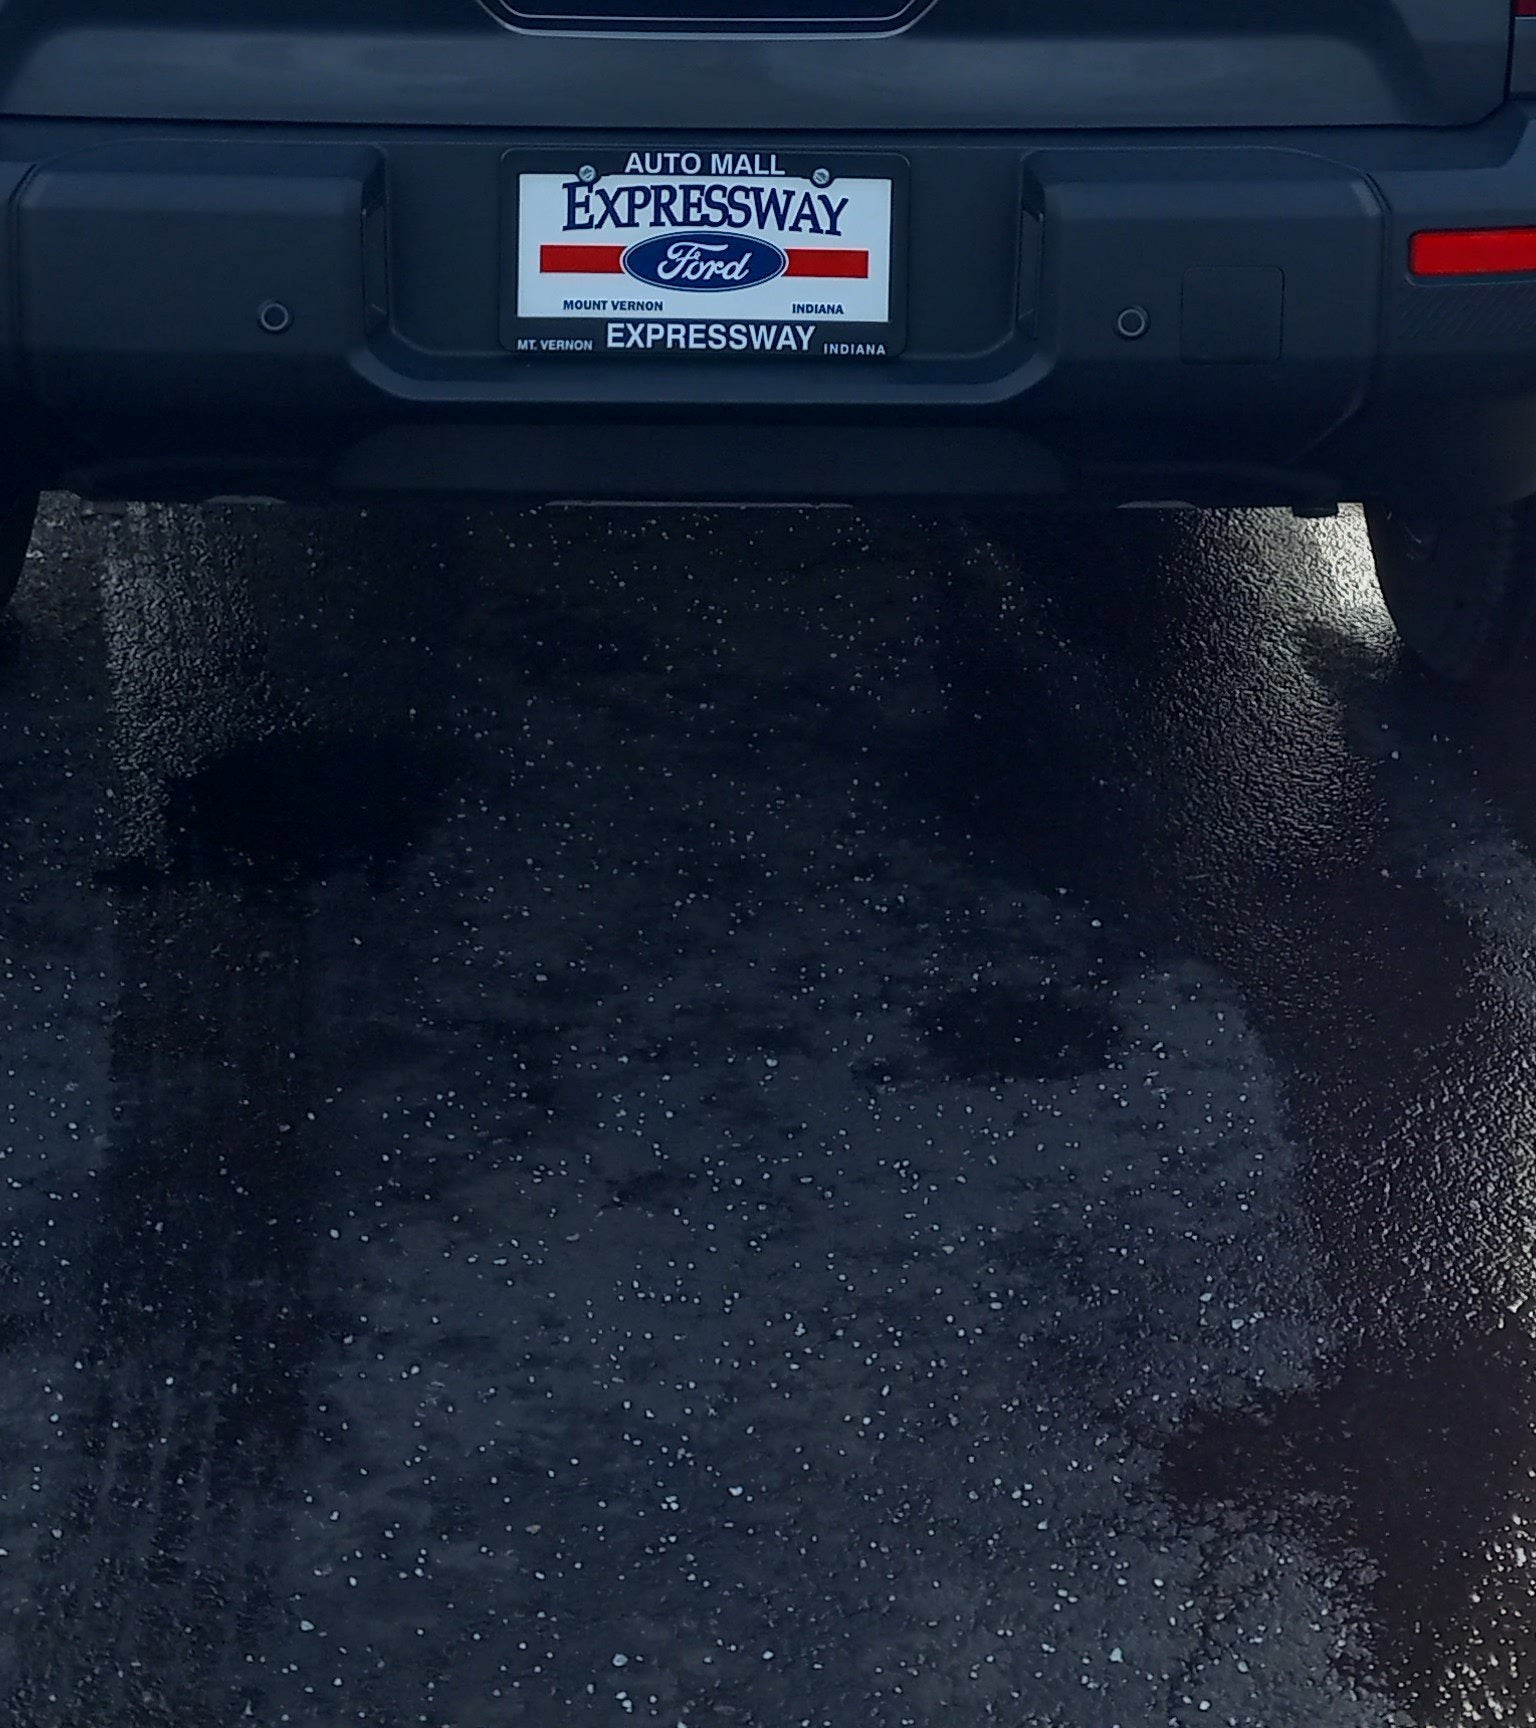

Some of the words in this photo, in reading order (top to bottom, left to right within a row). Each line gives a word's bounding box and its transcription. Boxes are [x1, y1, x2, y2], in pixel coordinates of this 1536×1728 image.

[625, 153, 702, 174] AUTO
[711, 154, 785, 175] MALL
[562, 181, 849, 236] EXPRESSWAY
[657, 242, 752, 280] Ford
[563, 300, 608, 311] MOUNT
[611, 300, 663, 312] VERNON
[791, 303, 844, 314] INDIANA
[517, 339, 537, 351] MT.
[541, 339, 592, 351] VERNON
[606, 323, 816, 352] EXPRESSWAY
[823, 343, 886, 355] INDIANA
